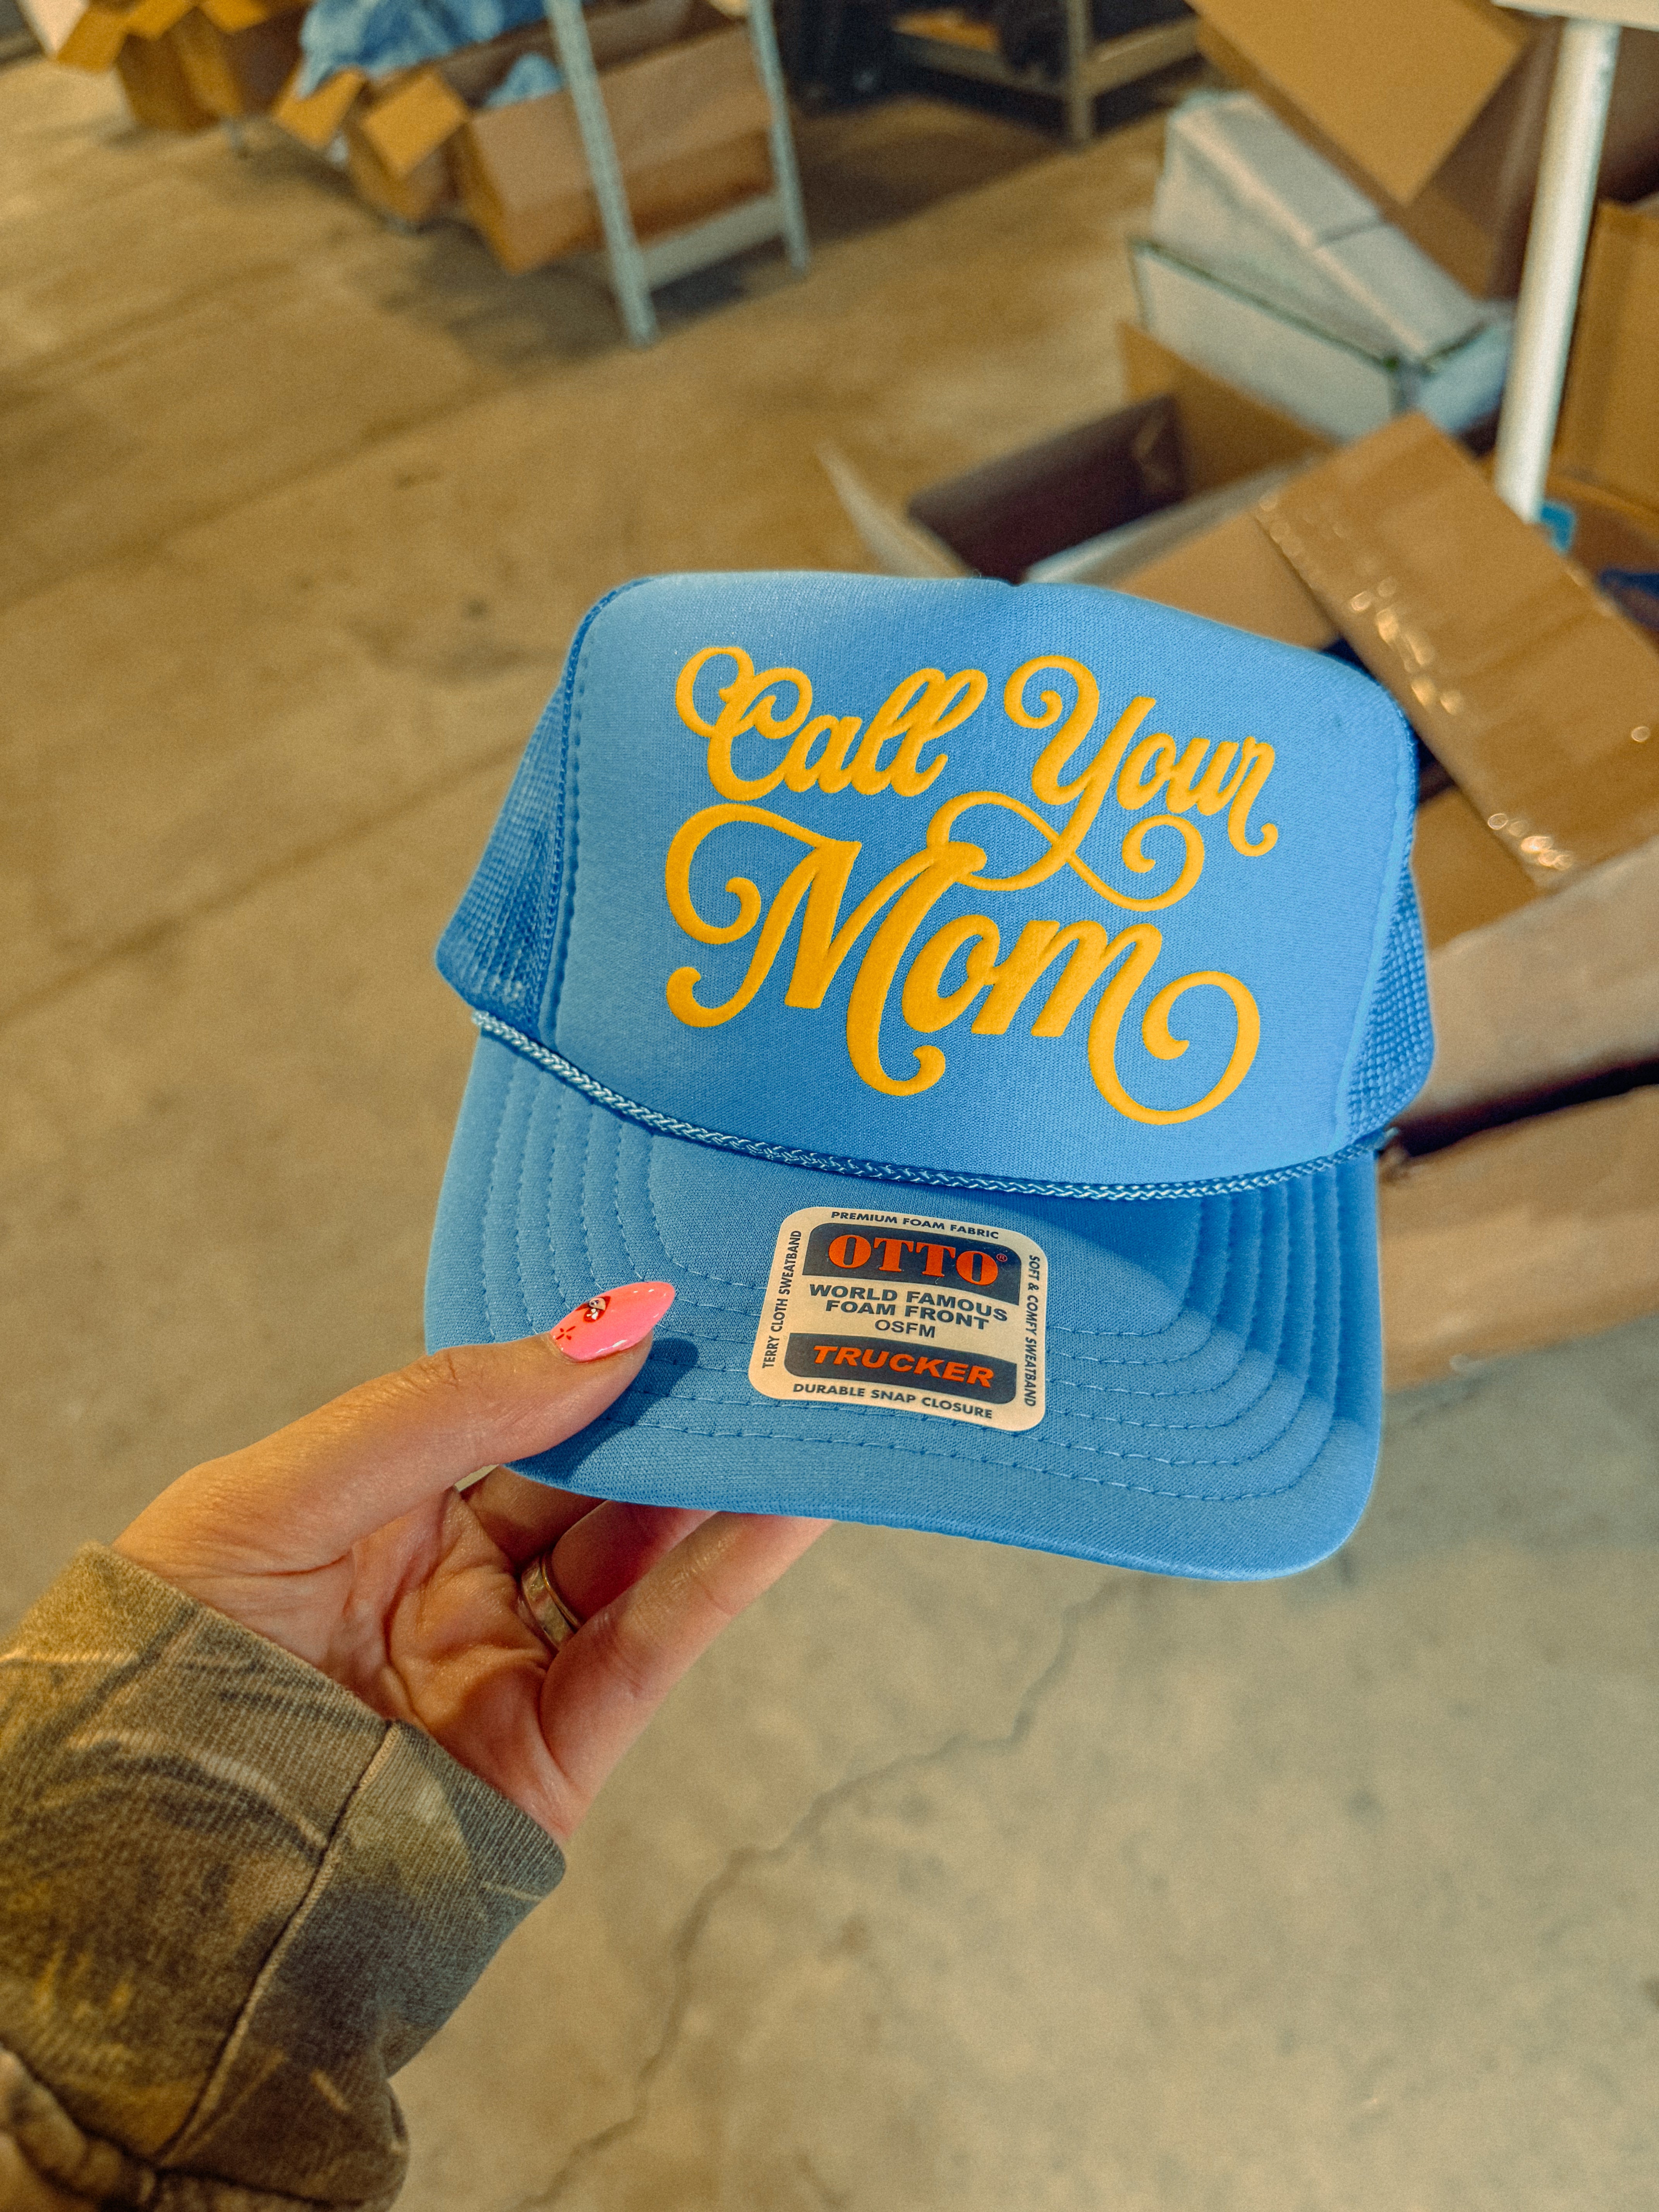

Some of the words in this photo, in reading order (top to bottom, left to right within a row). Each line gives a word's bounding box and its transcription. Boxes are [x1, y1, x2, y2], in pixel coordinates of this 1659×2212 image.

[675, 646, 988, 802] Call
[927, 655, 1278, 912] Your
[665, 803, 1261, 1126] Mom
[831, 1211, 898, 1224] PREMIUM
[903, 1218, 945, 1230] FOAM
[950, 1224, 999, 1239] FABRIC
[1028, 1255, 1040, 1280] SOFT
[762, 1335, 779, 1369] TERRY
[771, 1298, 787, 1333] CLOTH
[779, 1230, 802, 1295] SWEATBAND
[810, 1284, 897, 1301] WORLD
[907, 1292, 1007, 1321] FAMOUS
[1027, 1283, 1039, 1291] &
[826, 1300, 895, 1315] FOAM
[905, 1306, 989, 1329] FRONT
[875, 1320, 935, 1338] OSFM
[1026, 1295, 1038, 1336] COMFY
[814, 1345, 994, 1388] TRUCKER
[1024, 1337, 1036, 1407] SWEATBAND
[793, 1384, 864, 1398] DURABLE
[871, 1390, 915, 1402] SNAP
[922, 1398, 993, 1419] CLOSURE
